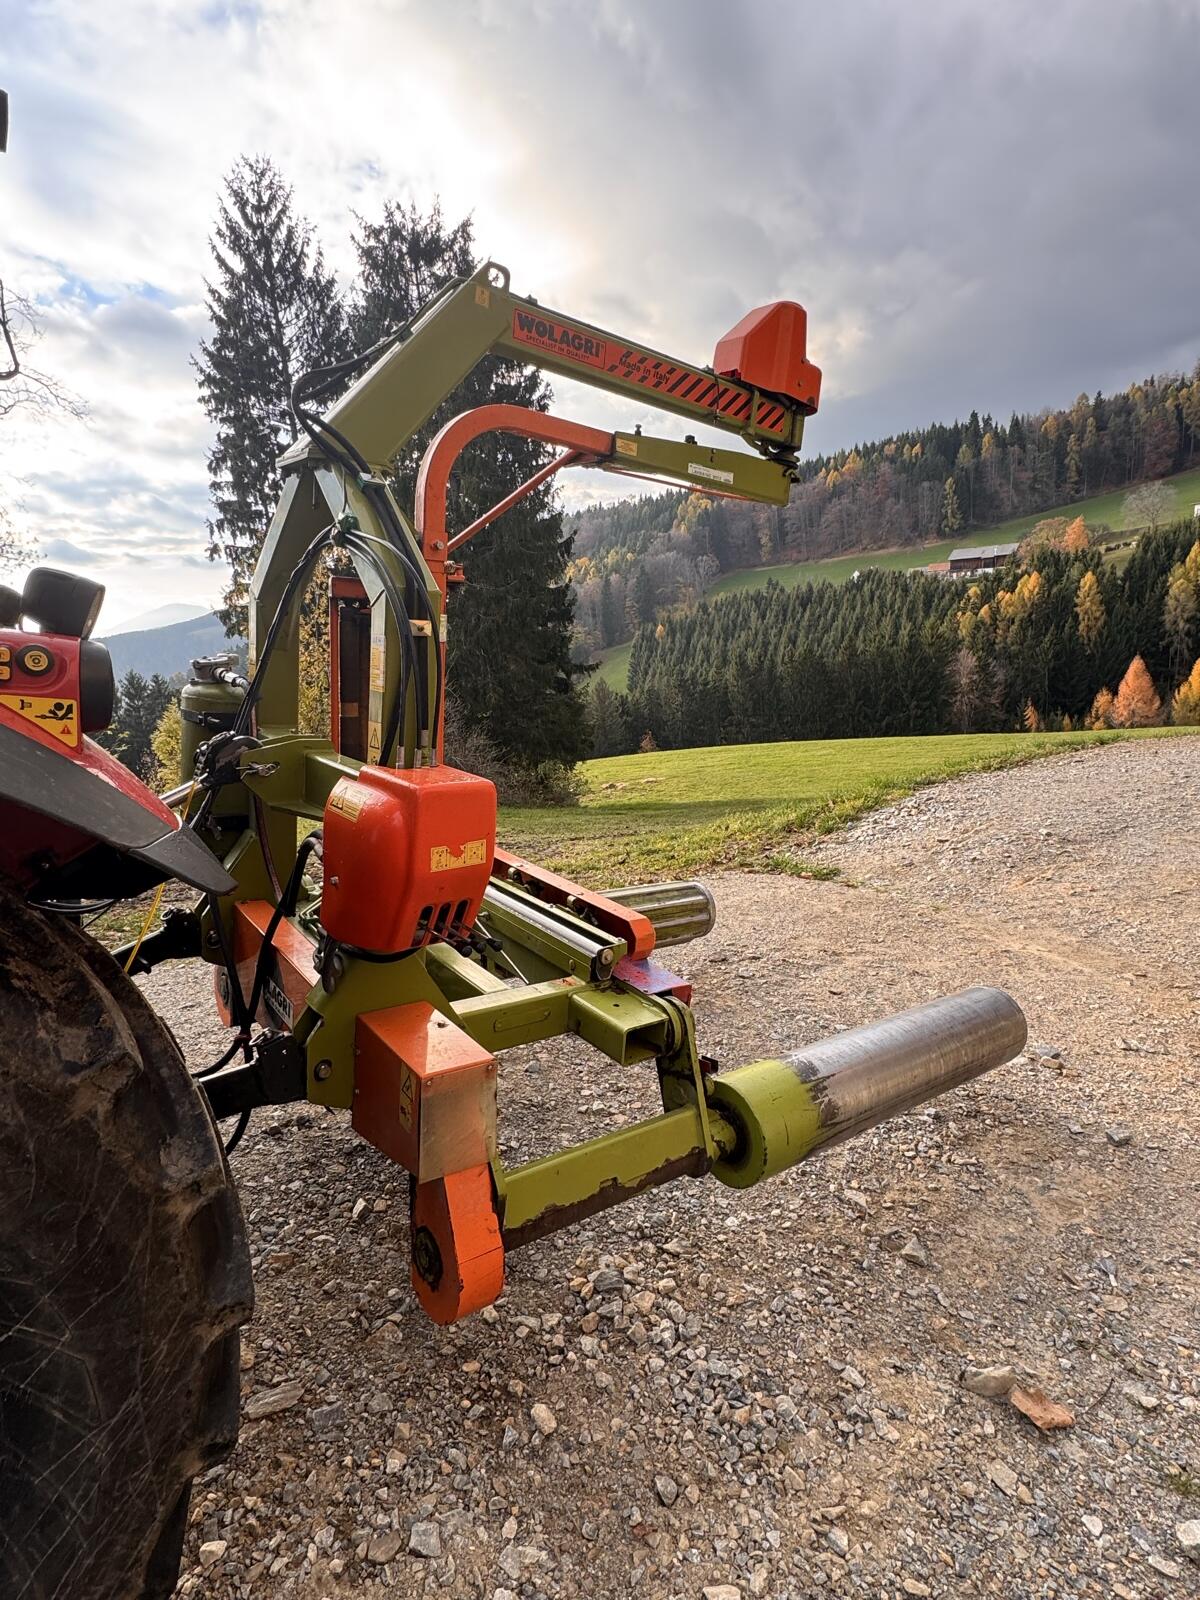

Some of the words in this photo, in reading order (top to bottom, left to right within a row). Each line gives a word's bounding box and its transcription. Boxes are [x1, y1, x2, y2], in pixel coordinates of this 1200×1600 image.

[516, 312, 601, 358] WOLAGRI
[566, 349, 590, 361] QUALITY
[619, 357, 641, 372] Made
[643, 366, 651, 376] in
